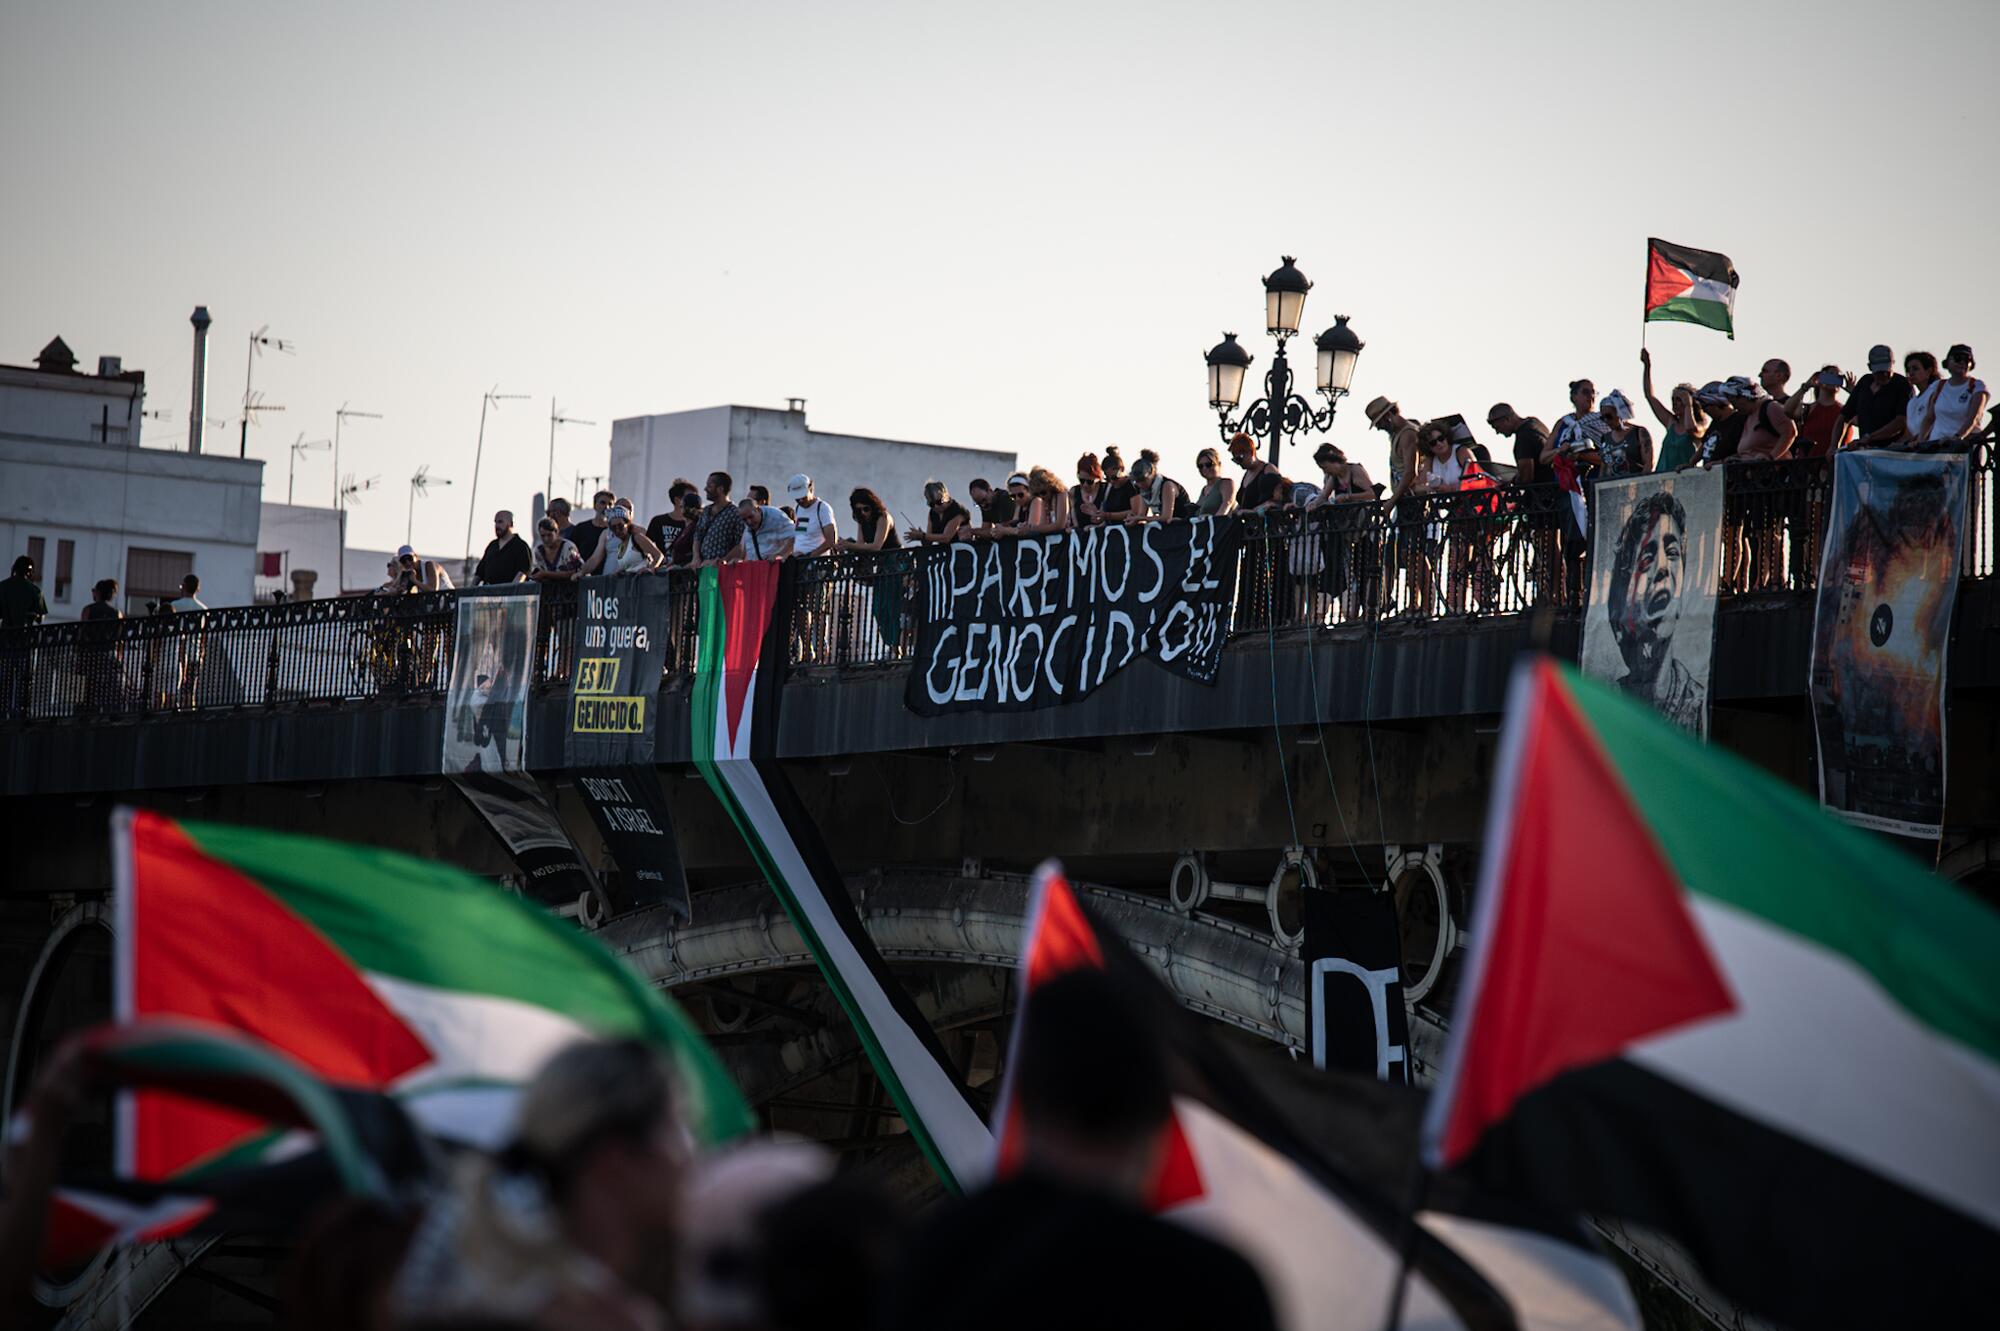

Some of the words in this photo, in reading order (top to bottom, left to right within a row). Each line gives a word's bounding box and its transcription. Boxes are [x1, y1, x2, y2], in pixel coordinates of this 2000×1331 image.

[1181, 515, 1220, 592] EL
[586, 588, 602, 619] No
[603, 596, 619, 620] es
[577, 661, 597, 690] ES
[602, 806, 622, 832] A
